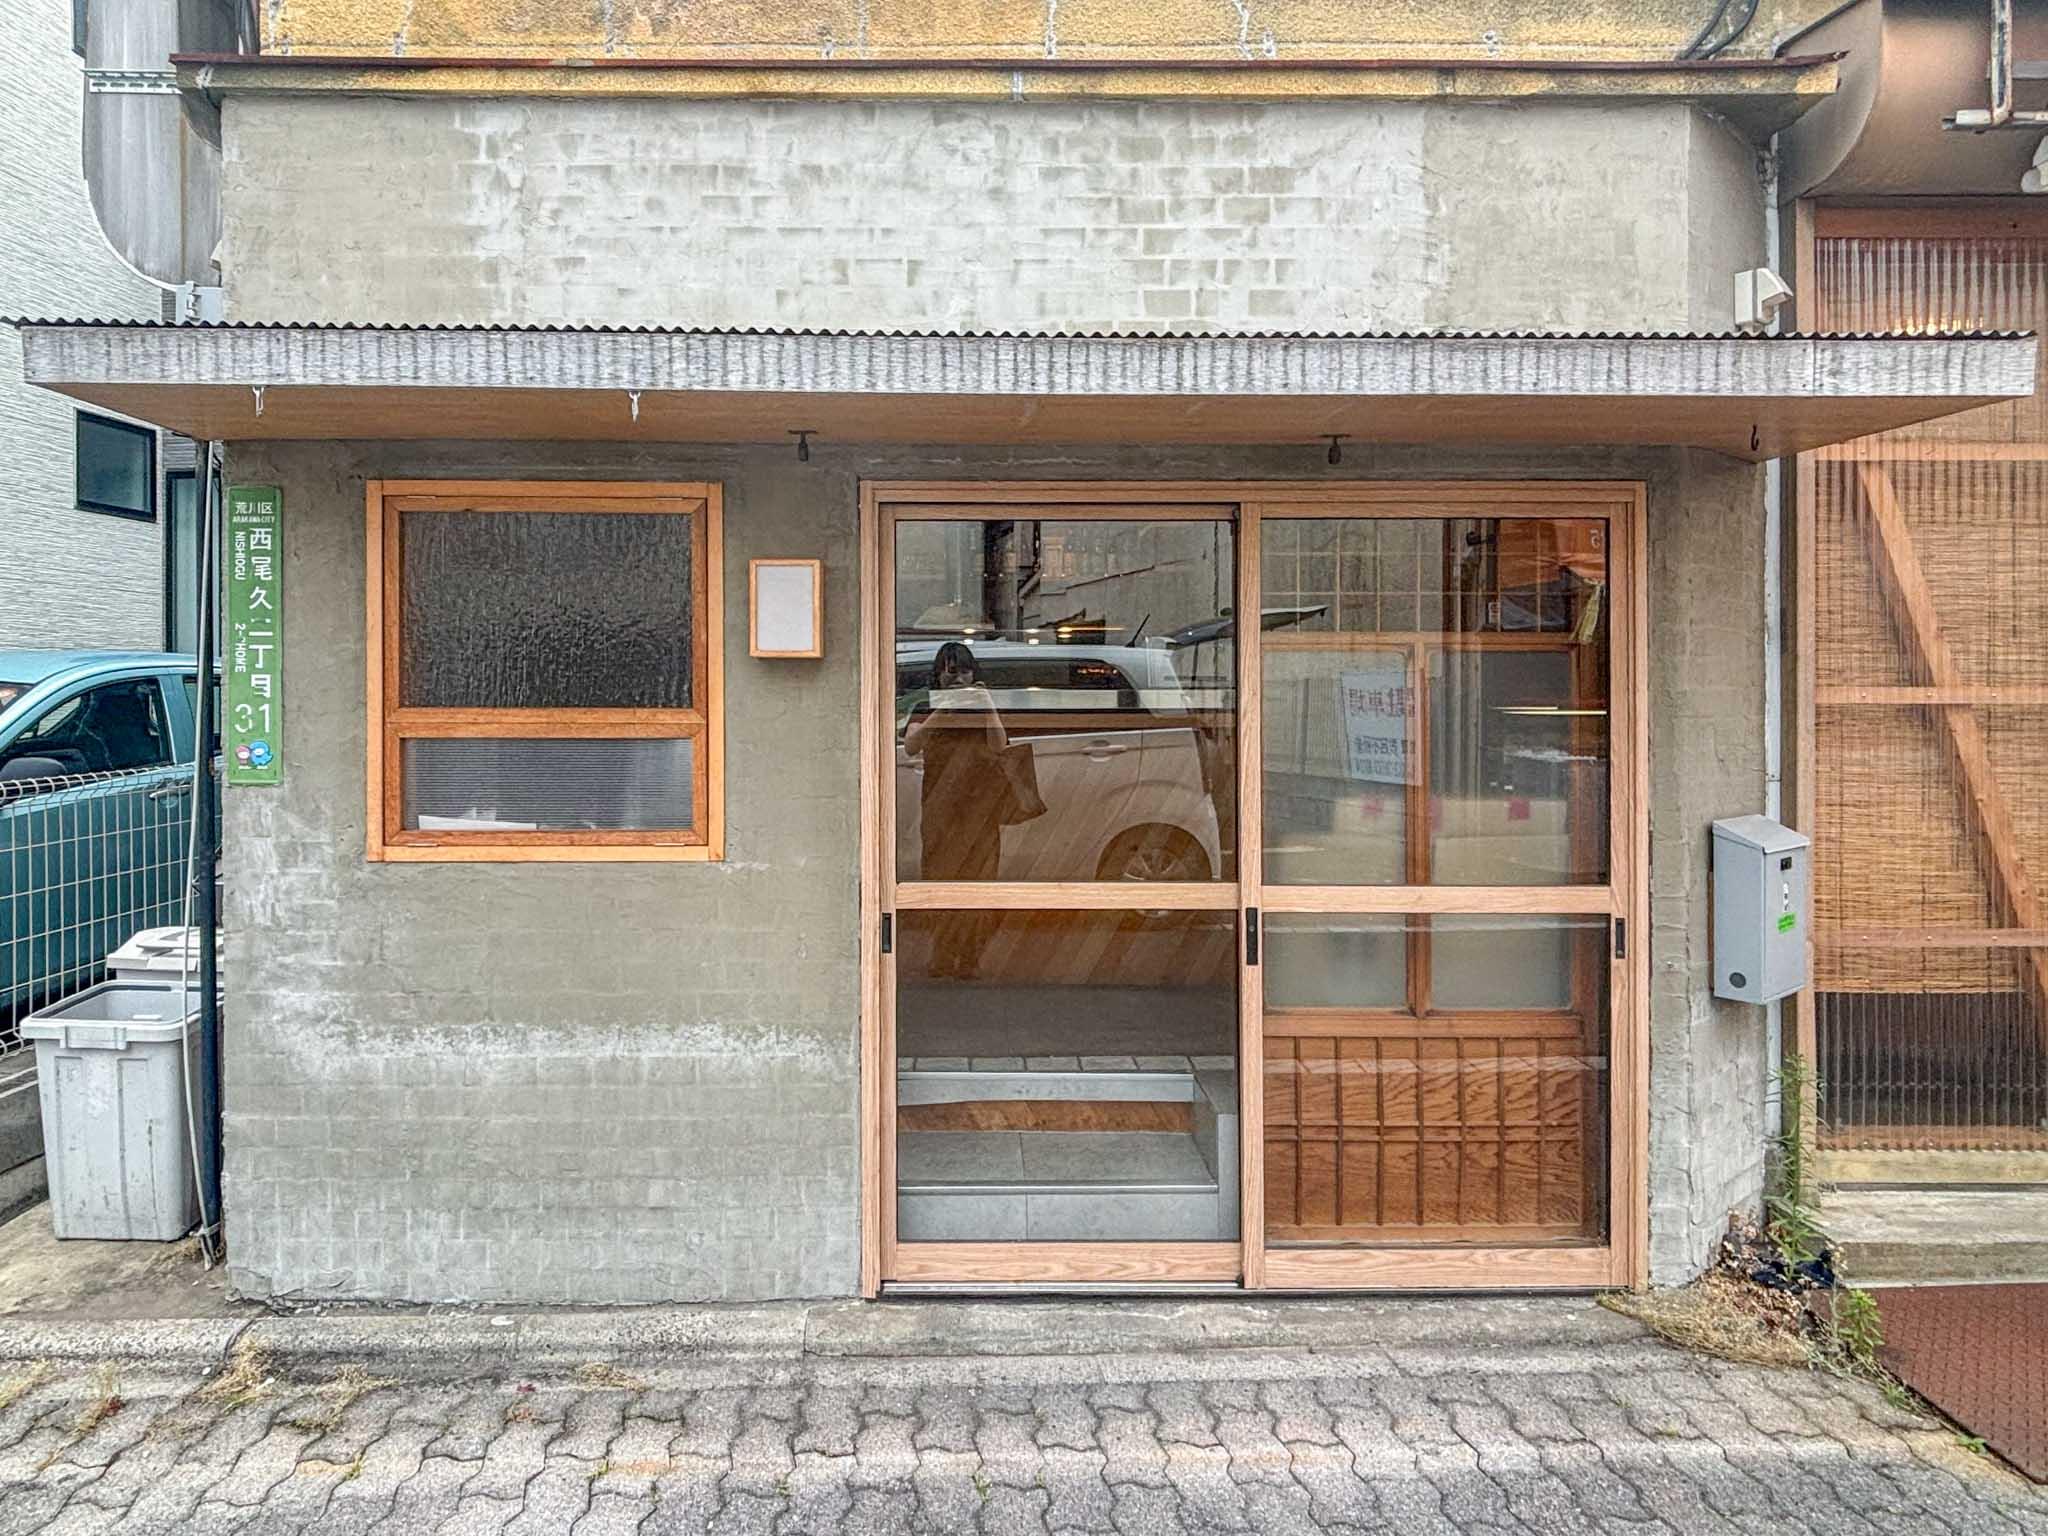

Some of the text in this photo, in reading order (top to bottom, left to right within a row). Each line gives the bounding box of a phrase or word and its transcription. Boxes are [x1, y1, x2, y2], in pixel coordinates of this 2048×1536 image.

[235, 501, 273, 514] 荒川区
[234, 531, 246, 581] NISHIOGU
[234, 703, 270, 733] 31
